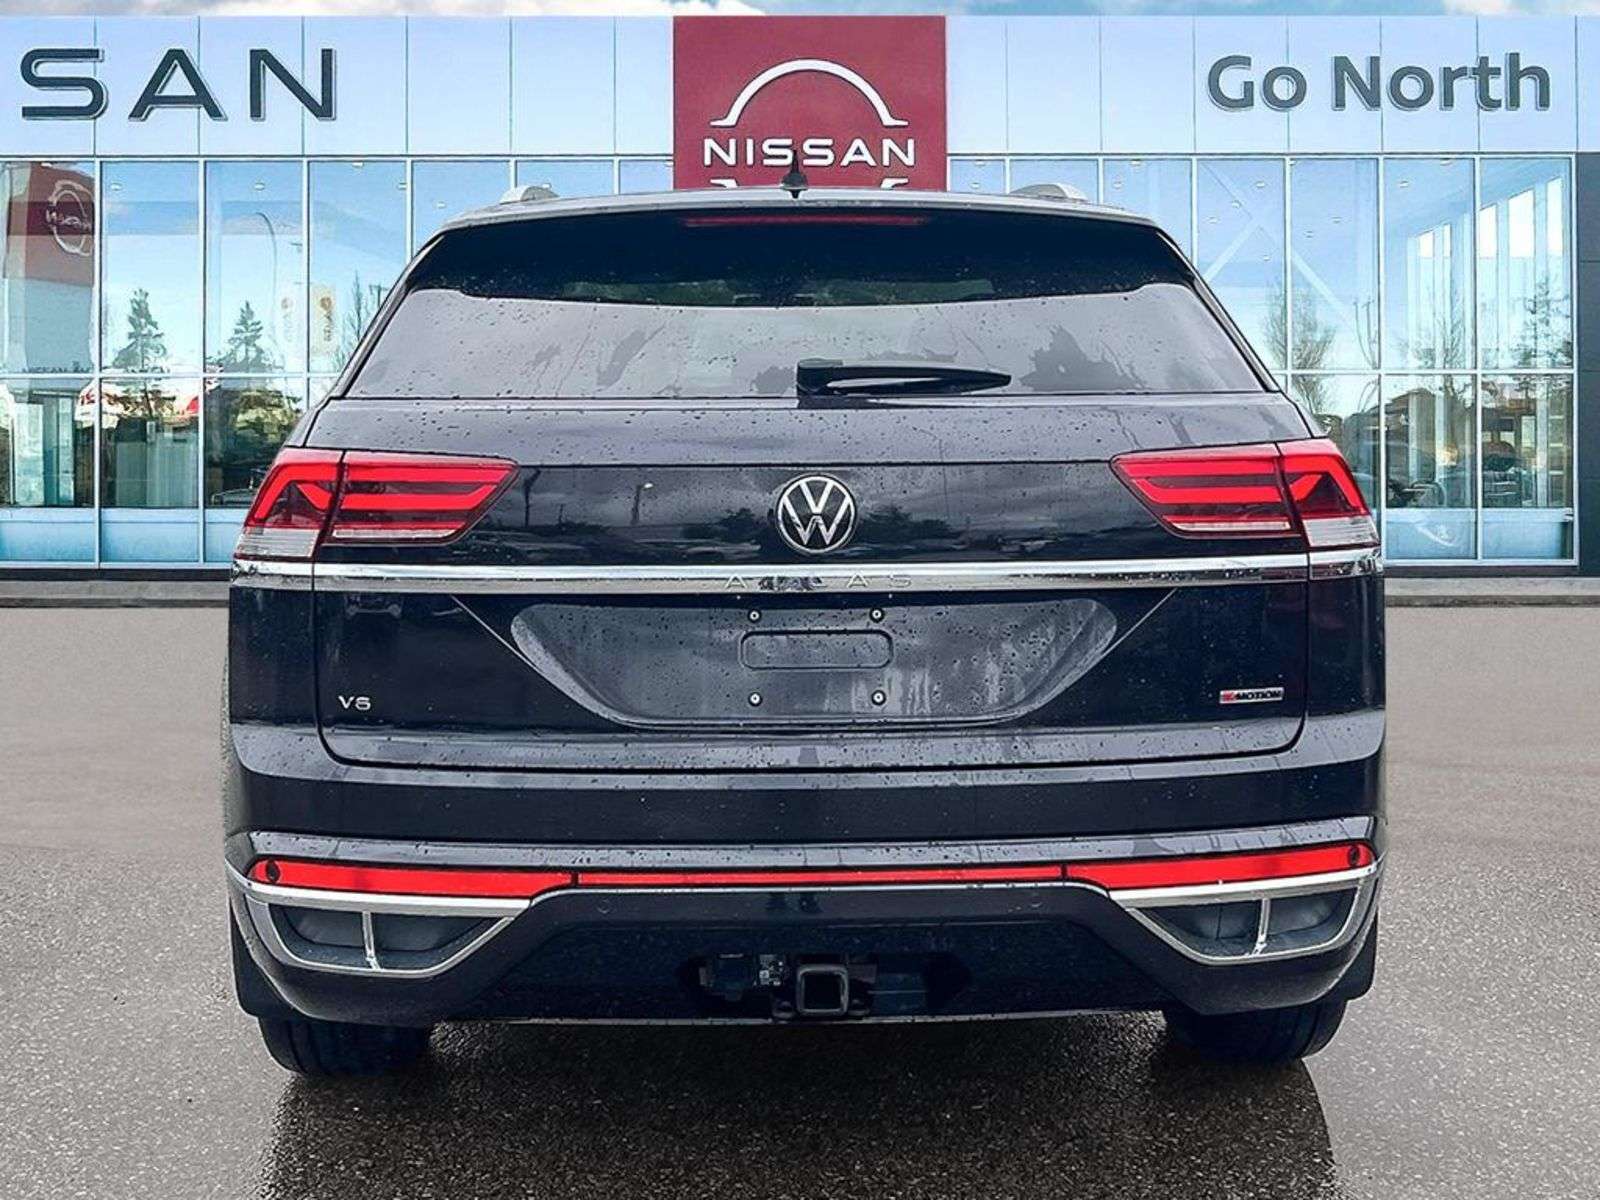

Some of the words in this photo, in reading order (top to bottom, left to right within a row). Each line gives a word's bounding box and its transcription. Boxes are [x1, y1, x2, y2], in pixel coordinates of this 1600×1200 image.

[20, 48, 337, 121] SAN
[1207, 54, 1307, 112] Go
[1331, 52, 1551, 112] North
[703, 137, 915, 167] NISSAN
[338, 695, 371, 710] V6
